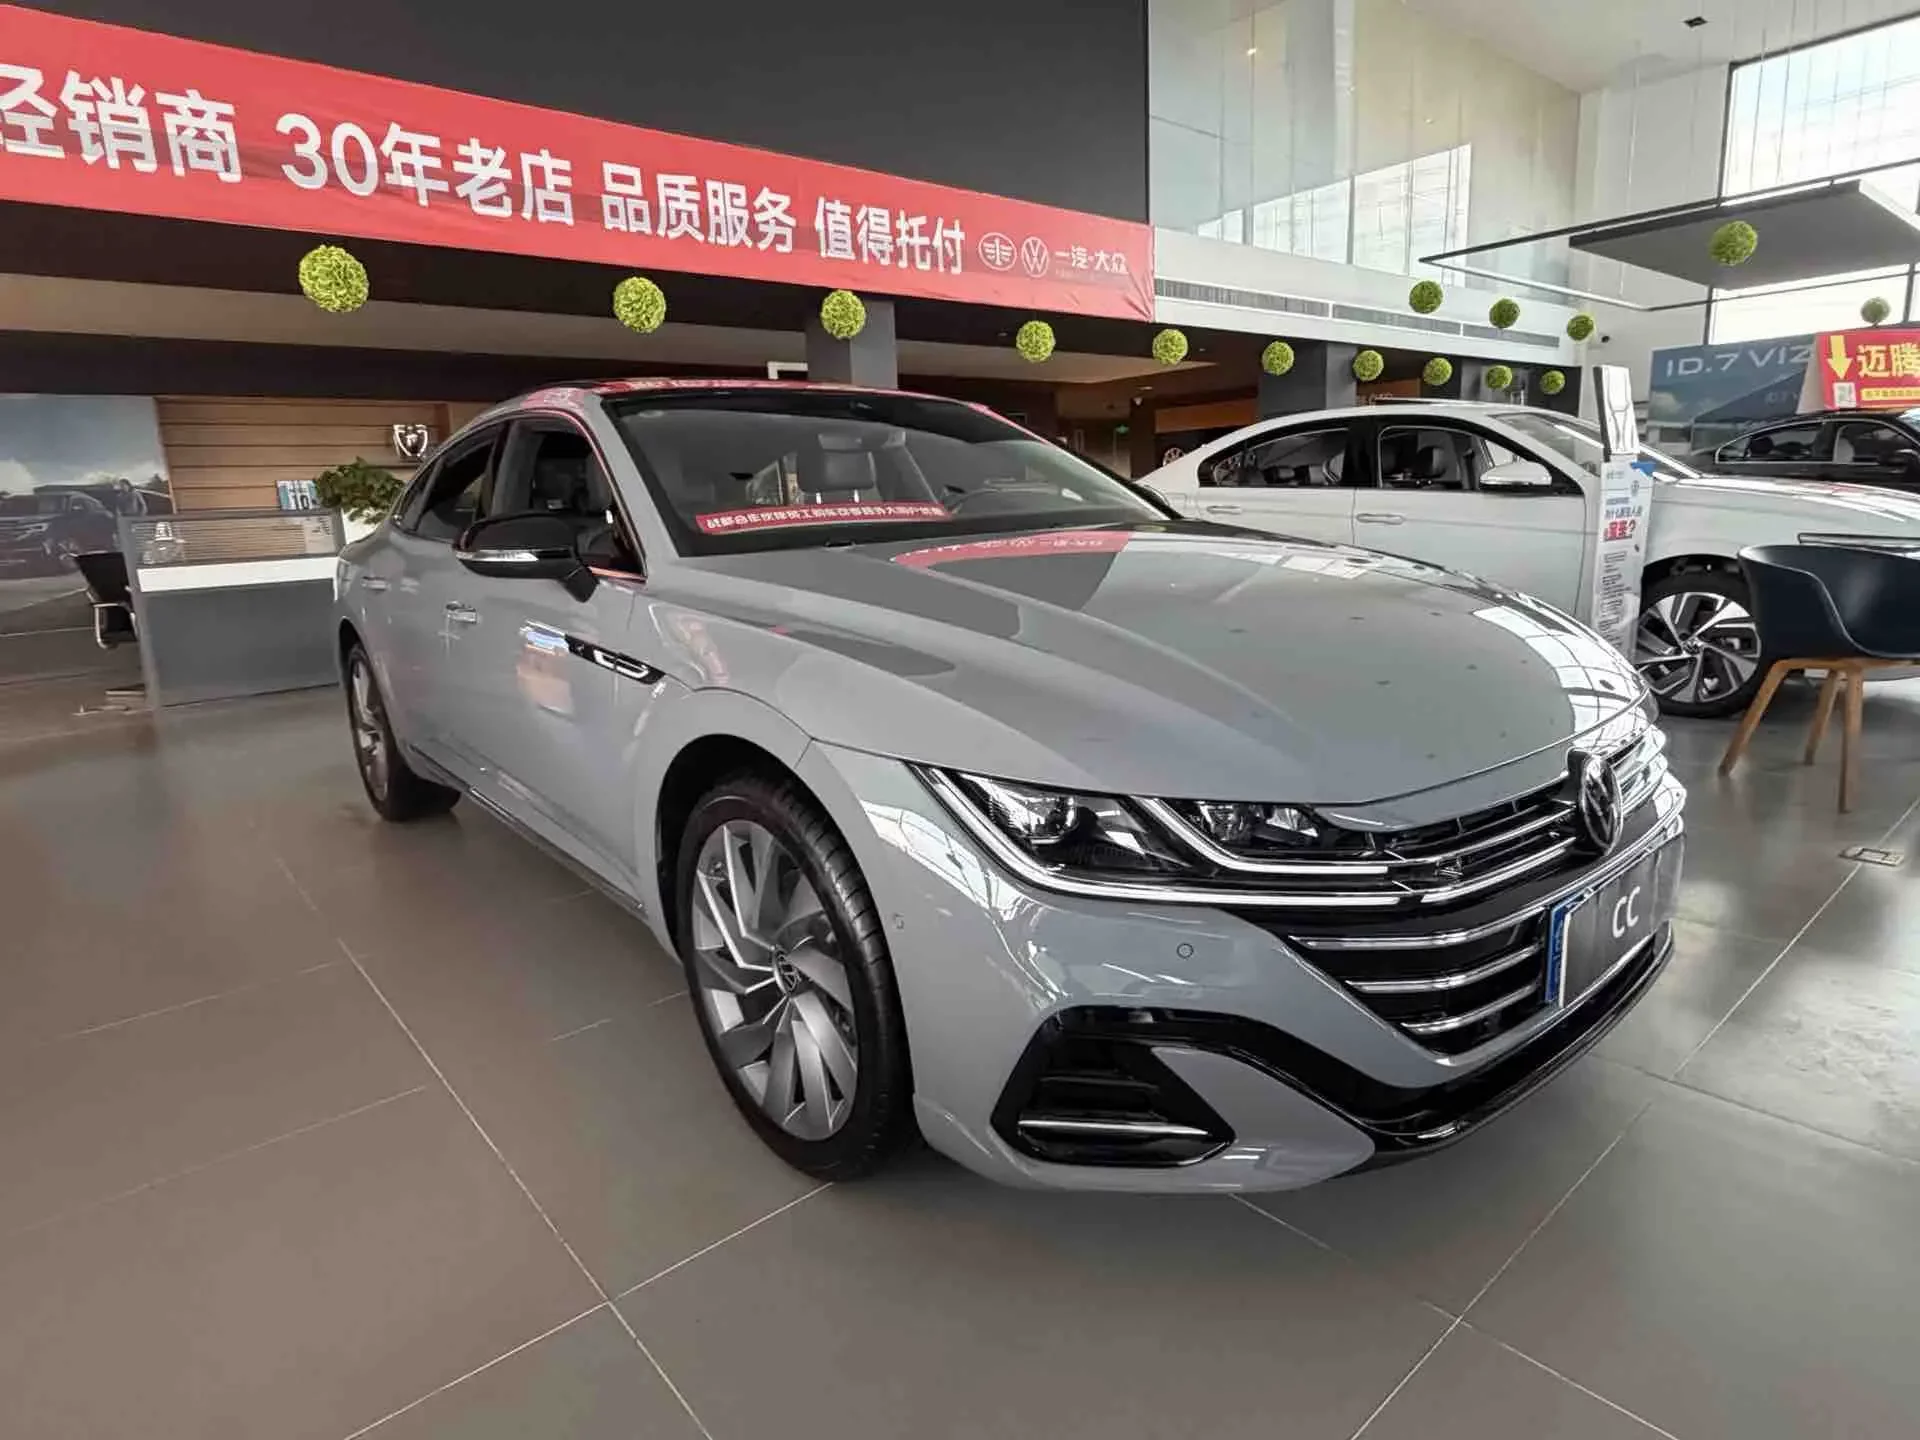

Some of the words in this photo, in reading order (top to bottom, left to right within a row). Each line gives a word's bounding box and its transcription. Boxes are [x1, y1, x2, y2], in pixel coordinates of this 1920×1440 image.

[275, 112, 575, 226] 30年老店
[601, 160, 797, 253] 品质服务
[814, 195, 966, 276] 值得托付
[1666, 352, 1741, 379] ID.7
[1612, 885, 1641, 938] CC
